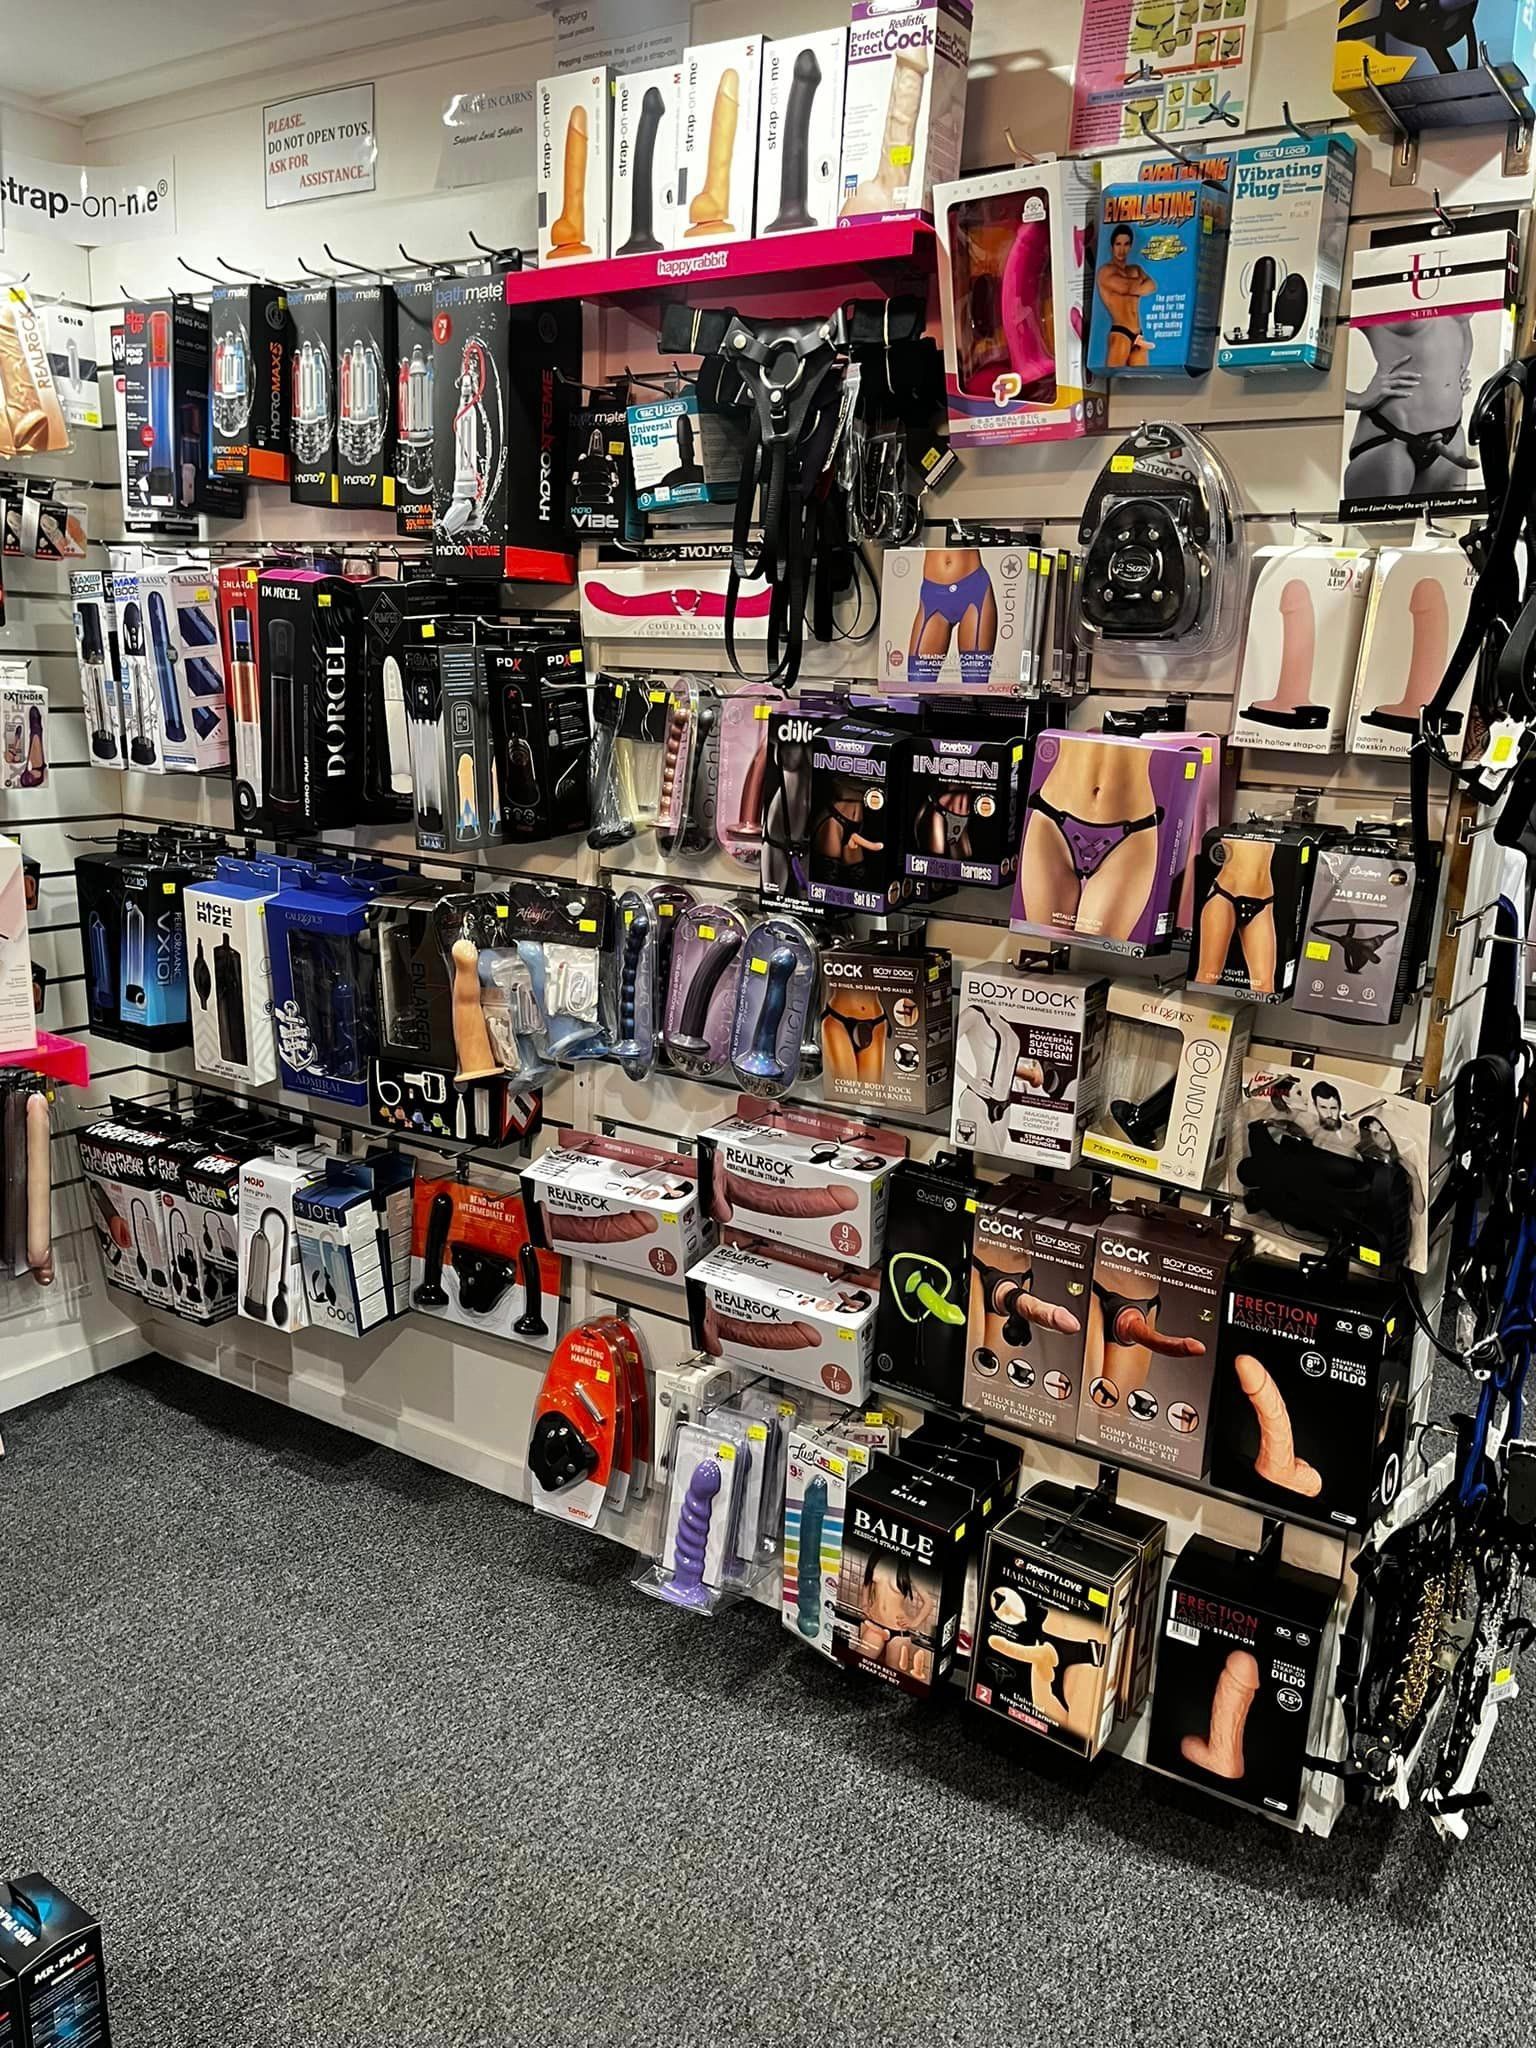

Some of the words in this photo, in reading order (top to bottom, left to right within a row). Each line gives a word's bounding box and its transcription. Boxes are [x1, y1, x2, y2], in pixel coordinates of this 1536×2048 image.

[558, 10, 588, 25] Pegging
[889, 14, 927, 31] Realistic
[851, 28, 884, 43] Perfect
[884, 25, 935, 51] Cock
[850, 42, 884, 57] Erect
[498, 90, 533, 107] CAIRNS
[269, 141, 281, 155] DO
[284, 134, 304, 151] NOT
[307, 127, 338, 146] OPEN
[453, 134, 478, 146] Support
[497, 127, 523, 140] Supplier
[269, 158, 287, 175] ASK
[288, 154, 308, 169] FOR
[1238, 162, 1323, 181] Vibrating
[1236, 182, 1280, 200] Plug
[1103, 191, 1196, 224] EVERLASTING
[694, 253, 726, 268] rabbit
[1402, 268, 1452, 281] STRAP
[1408, 250, 1449, 301] U
[435, 282, 504, 303] bathmate
[58, 316, 84, 327] SONO
[1410, 308, 1439, 319] SUTRA
[664, 404, 686, 414] LOCK
[630, 421, 674, 435] Universal
[632, 434, 660, 448] Plug
[1136, 460, 1174, 477] STRAP
[294, 472, 326, 484] HYDRO7
[343, 474, 376, 486] HYDRO7
[571, 506, 592, 514] HYDRO
[1388, 502, 1404, 512] Strap
[1430, 499, 1457, 508] Vibrator
[571, 514, 620, 529] VIBE
[436, 545, 500, 559] HYDROXTREME
[71, 584, 101, 594] BOOST
[261, 585, 301, 600] DORCEL
[374, 610, 400, 624] PUMPED
[1000, 583, 1017, 640] Ouch!
[648, 622, 697, 631] COUPLED
[496, 658, 522, 671] PDX
[326, 635, 346, 778] DORCEL
[834, 741, 866, 753] lovetoy
[940, 741, 973, 754] lovetoy
[1235, 736, 1262, 745] flexskin
[1264, 737, 1291, 748] hollow
[1293, 738, 1327, 751] strap-on
[1356, 742, 1388, 752] flexskin
[813, 752, 887, 776] INGEN
[912, 755, 999, 780] INGEN
[911, 856, 928, 875] Easy
[960, 862, 992, 880] harness
[811, 884, 826, 902] Easy
[1334, 889, 1358, 900] JAB
[1358, 891, 1388, 902] STRAP
[197, 912, 233, 928] RIZE
[1052, 912, 1076, 922] METALLIC
[1102, 942, 1130, 953] Ouch!
[823, 962, 864, 978] COCK
[872, 968, 892, 976] BODY
[892, 969, 914, 978] DOCK
[968, 980, 1017, 1000] BODY
[1022, 989, 1077, 1010] DOCK
[1234, 990, 1264, 1001] Ouch!
[412, 962, 430, 1056] ENLARGER
[968, 997, 997, 1006] UNIVERSAL
[1026, 1005, 1052, 1014] HARNESS
[1054, 1008, 1076, 1017] SYSTEM
[1029, 1033, 1074, 1046] POWERFUL
[1029, 1040, 1074, 1053] SUCTION
[1028, 1048, 1073, 1062] DESIGN!
[296, 1074, 343, 1092] ADMIRAL
[834, 1078, 862, 1088] COMFY
[864, 1082, 887, 1092] BODY
[888, 1085, 912, 1094] DOCK
[834, 1086, 874, 1098] STRAP-ON
[875, 1091, 913, 1102] HARNESS
[1177, 1044, 1217, 1158] BOUNDLESS
[1019, 1137, 1061, 1150] SUSPENDERS
[1024, 1133, 1056, 1144] STRAP-ON
[116, 1152, 144, 1167] PUMP
[116, 1162, 146, 1177] WORX
[244, 1175, 264, 1188] MOJO
[764, 1172, 786, 1184] STRAP-ON
[470, 1194, 486, 1206] BEND
[916, 1188, 945, 1204] Ouch!
[308, 1205, 340, 1224] JOEL
[458, 1201, 504, 1221] INTERMEDIATE
[504, 1213, 516, 1224] KIT
[978, 1218, 1024, 1241] COCK
[1035, 1234, 1058, 1246] BODY
[1058, 1239, 1082, 1251] DOCK
[1035, 1251, 1054, 1262] BASED
[1055, 1256, 1085, 1270] HARNESS!
[1100, 1240, 1150, 1265] COCK
[1162, 1258, 1186, 1272] BODY
[1188, 1263, 1214, 1278] DOCK
[1100, 1260, 1132, 1274] PATENTED
[1134, 1268, 1162, 1282] SUCTION
[1162, 1276, 1184, 1288] BASED
[1184, 1282, 1218, 1296] HARNESS!
[732, 1306, 752, 1320] STRAP-ON
[1234, 1294, 1318, 1326] ERECTION
[1234, 1310, 1316, 1338] ASSISTANT
[1234, 1319, 1270, 1335] HOLLOW
[1272, 1328, 1316, 1346] STRAP-ON
[570, 1344, 604, 1360] VIBRATING
[570, 1354, 602, 1369] HARNESS
[1330, 1362, 1366, 1378] STRAP-ON
[1330, 1369, 1367, 1387] DILDO
[982, 1392, 1014, 1407] DELUXE
[1018, 1403, 1056, 1421] SILICONE
[984, 1399, 1007, 1412] BODY
[1038, 1417, 1054, 1428] KIT
[1100, 1424, 1134, 1440] COMFY
[1136, 1435, 1180, 1456] SILICONE
[1100, 1432, 1128, 1446] BODY
[1128, 1440, 1158, 1455] DOCK
[1160, 1448, 1178, 1462] KIT
[891, 1488, 928, 1507] BAILE
[853, 1528, 880, 1544] JESSICA
[880, 1538, 901, 1552] STRAP
[854, 1508, 934, 1558] BAILE
[1002, 1566, 1050, 1594] HARNESS
[1052, 1588, 1090, 1612] BRIEFS
[1177, 1592, 1258, 1628] ERECTION
[1176, 1606, 1256, 1640] ASSISTANT
[1176, 1615, 1211, 1632] HOLLOW
[1213, 1627, 1256, 1646] STRAP-ON
[858, 1662, 877, 1675] STRAP
[862, 1658, 880, 1670] SUPER
[1272, 1664, 1306, 1680] STRAP-ON
[1271, 1669, 1306, 1688] DILDO
[979, 1688, 989, 1700] 2
[1032, 1707, 1060, 1728] Harness
